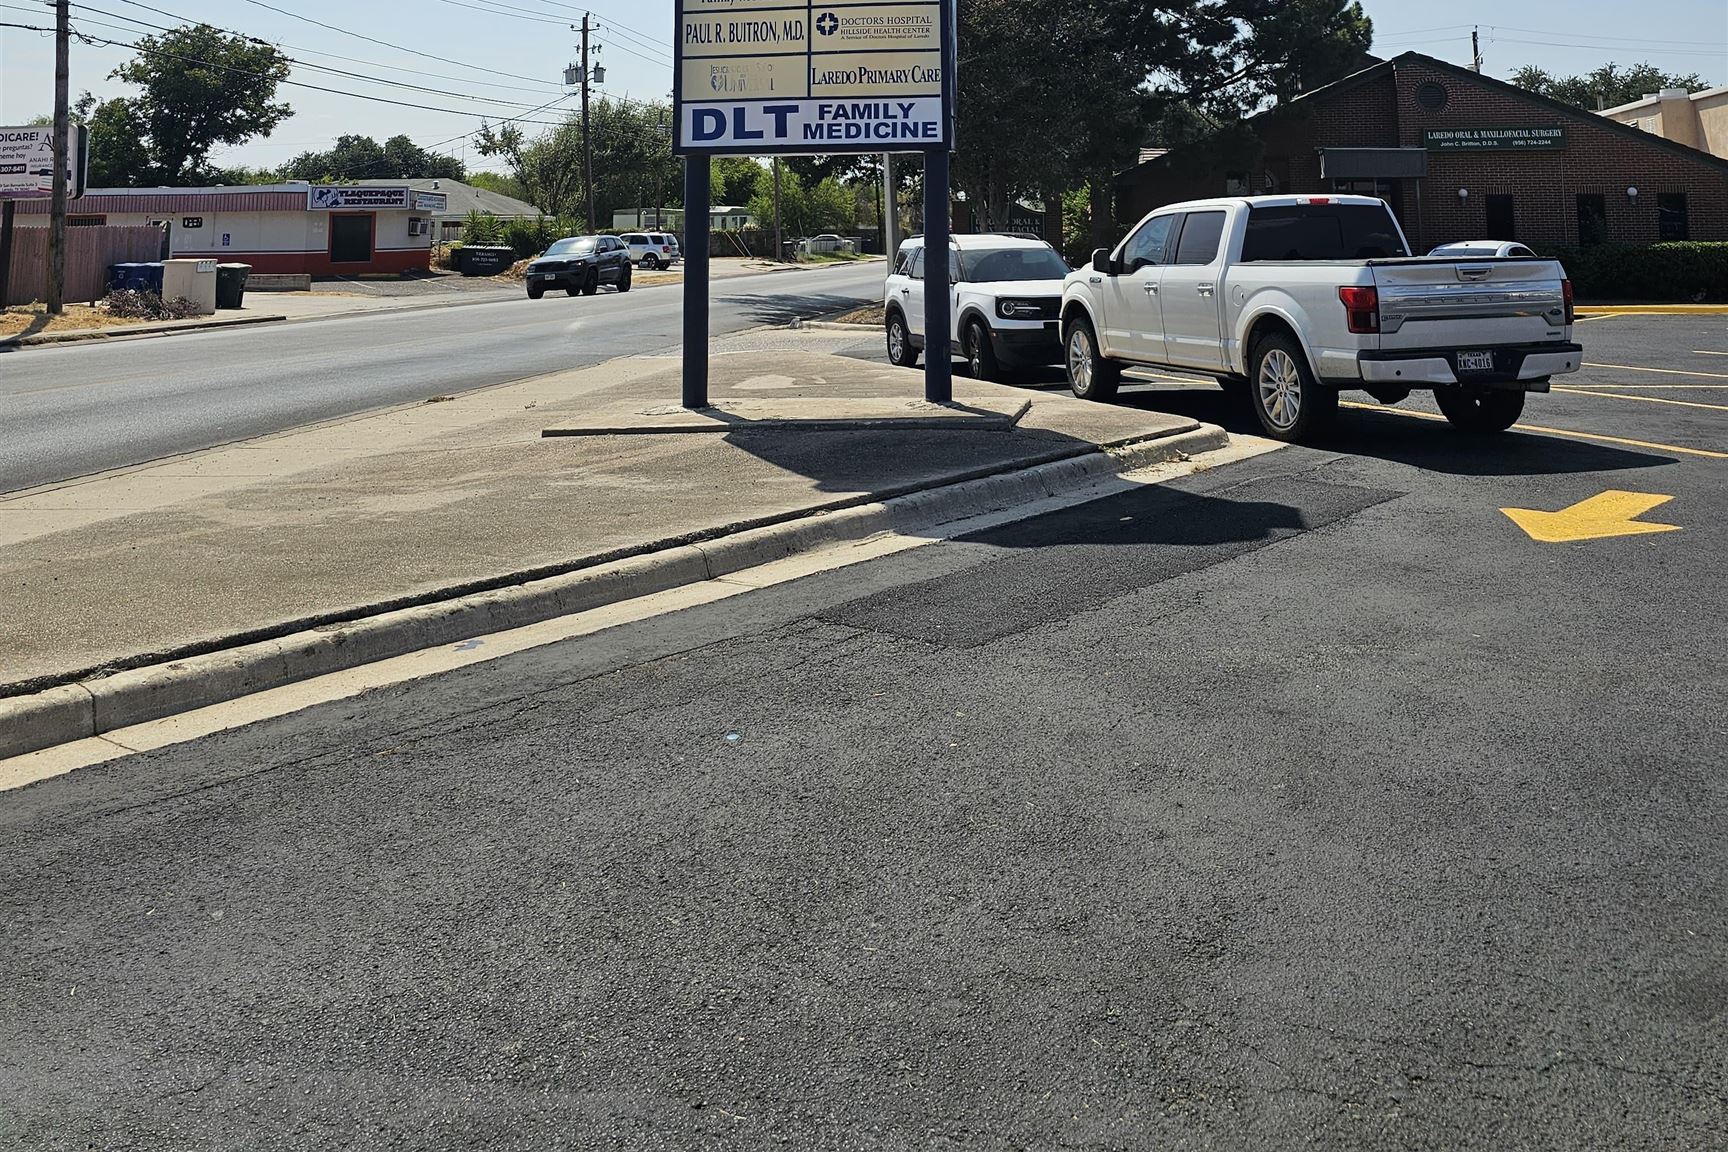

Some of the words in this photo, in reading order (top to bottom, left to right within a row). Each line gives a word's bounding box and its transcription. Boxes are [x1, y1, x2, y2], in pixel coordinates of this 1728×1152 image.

[841, 16, 884, 25] DOCTORS
[887, 16, 932, 25] HOSPITAL
[685, 23, 712, 44] PAUL
[715, 23, 725, 43] R.
[729, 21, 780, 44] BUITRON,
[783, 20, 805, 41] M.D.
[812, 67, 856, 85] LAREDO
[858, 66, 910, 84] PRIMARY
[911, 65, 941, 83] CARE
[818, 102, 916, 120] FAMILY
[691, 104, 799, 141] DLT
[803, 121, 938, 140] MEDICINE
[1428, 131, 1454, 139] LAREDO
[1455, 131, 1473, 139] ORAL
[1480, 130, 1531, 138] MAXILLOFACIAL
[1531, 129, 1562, 137] SURGERY
